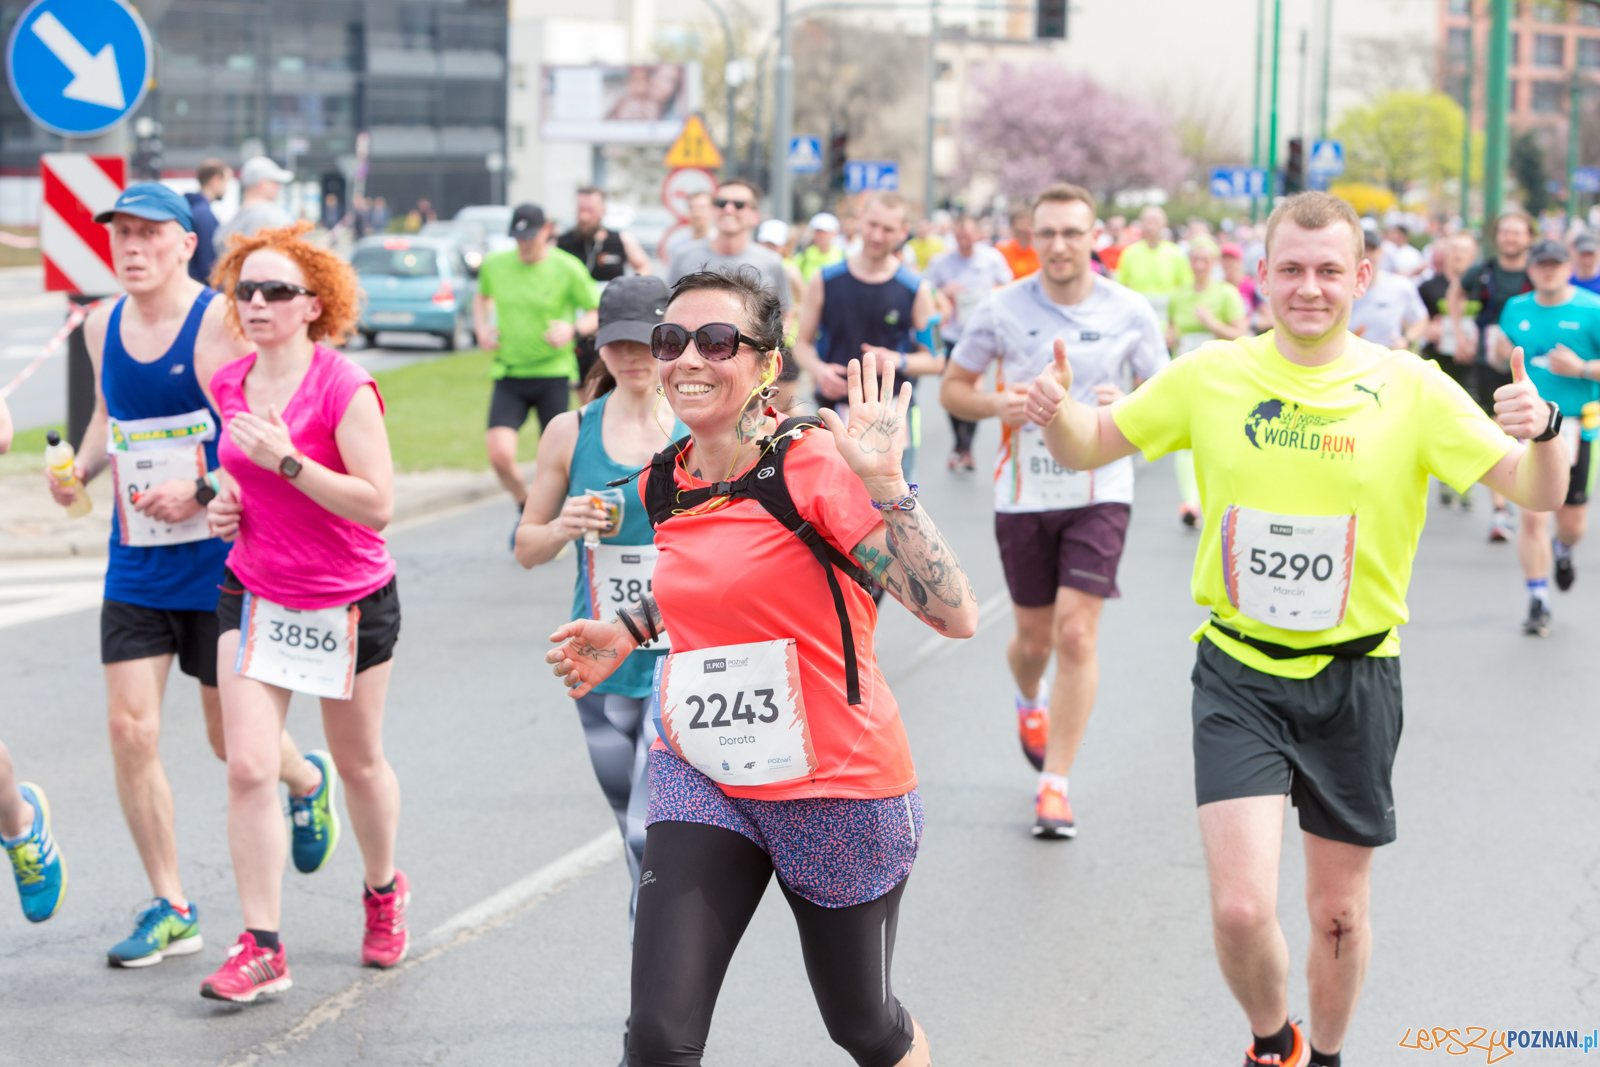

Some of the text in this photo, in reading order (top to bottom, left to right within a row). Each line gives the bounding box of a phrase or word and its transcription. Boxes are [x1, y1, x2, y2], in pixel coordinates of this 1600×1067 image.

[1282, 411, 1322, 425] WINGS
[1249, 548, 1334, 582] 5290
[1273, 585, 1305, 597] Marcin
[269, 620, 337, 652] 3856
[705, 661, 726, 670] 11.PKO
[685, 688, 780, 730] 2243
[718, 734, 756, 746] Dorota
